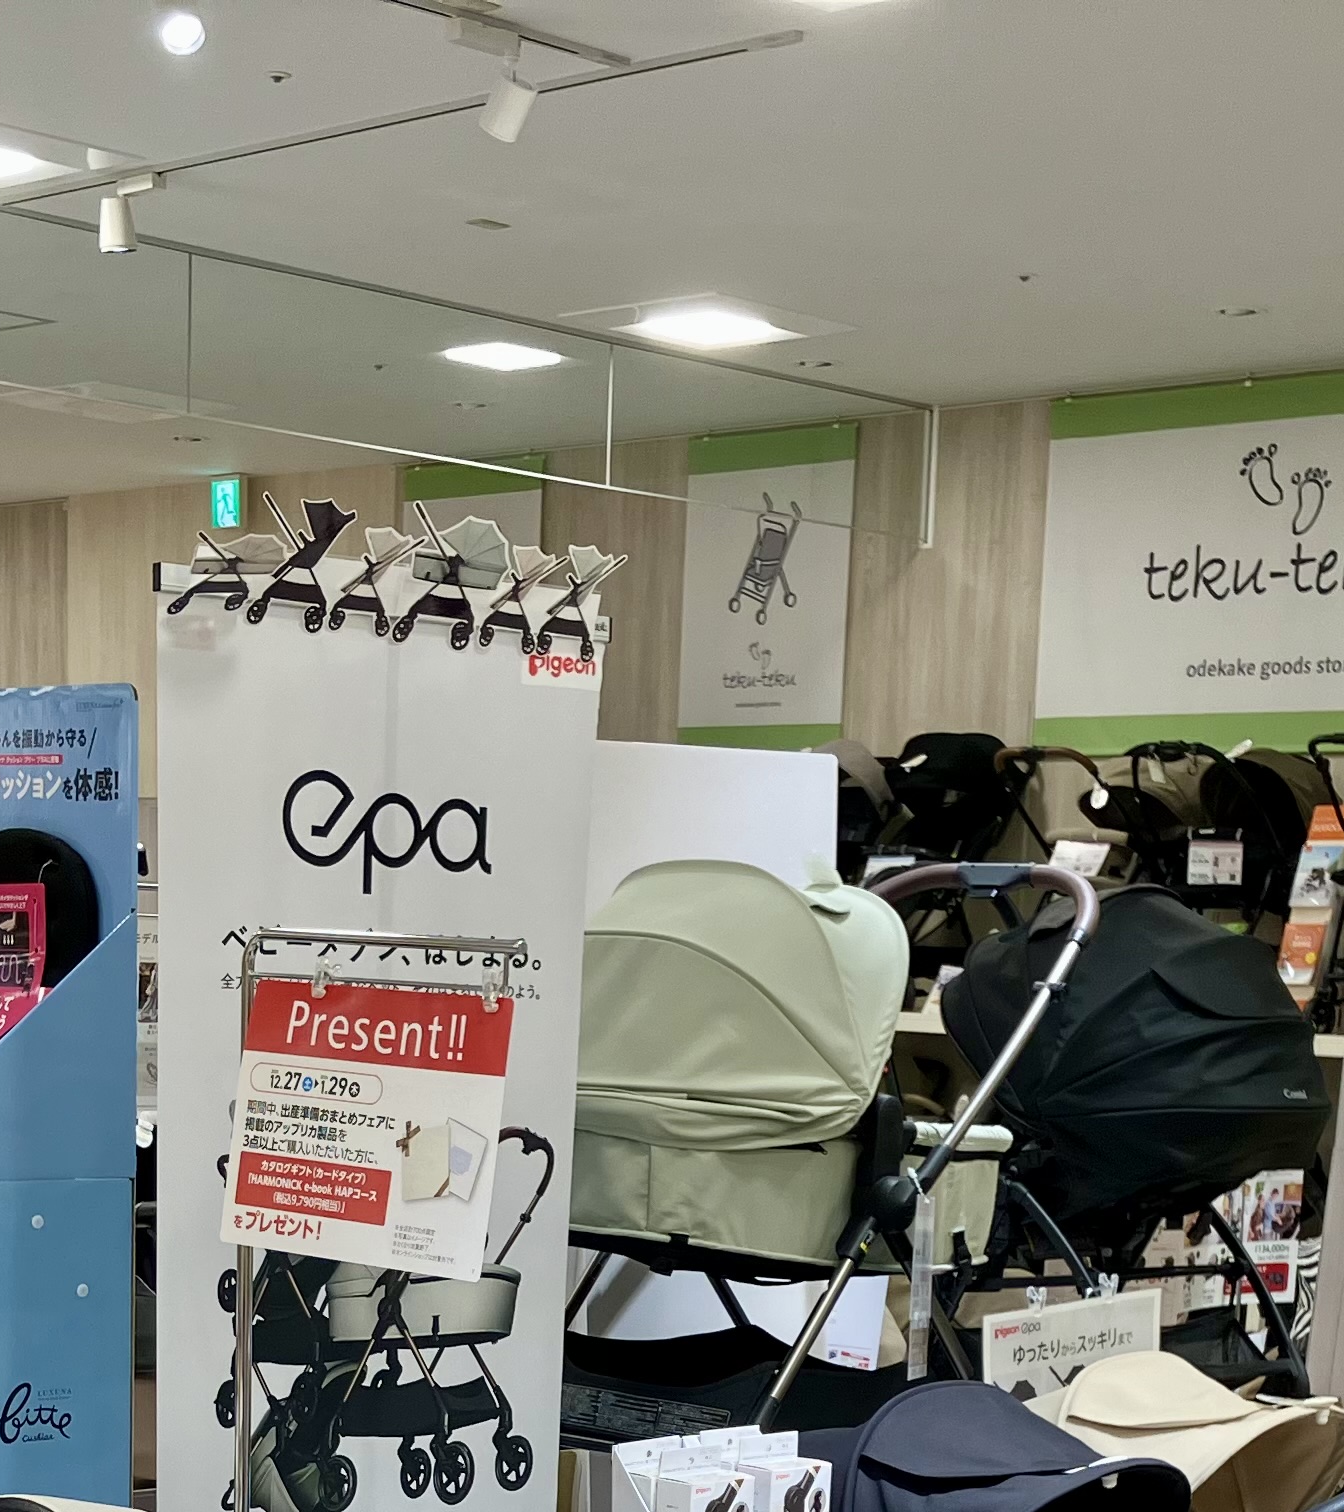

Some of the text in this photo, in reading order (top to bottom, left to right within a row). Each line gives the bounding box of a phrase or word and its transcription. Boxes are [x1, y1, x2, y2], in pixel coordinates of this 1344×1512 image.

[1185, 658, 1257, 679] odekake
[1259, 657, 1313, 681] goods
[282, 769, 493, 895] epa
[286, 1000, 468, 1063] Present!!
[1012, 1327, 1134, 1366] ゆったりからスッキリまで
[1021, 1320, 1042, 1337] epa
